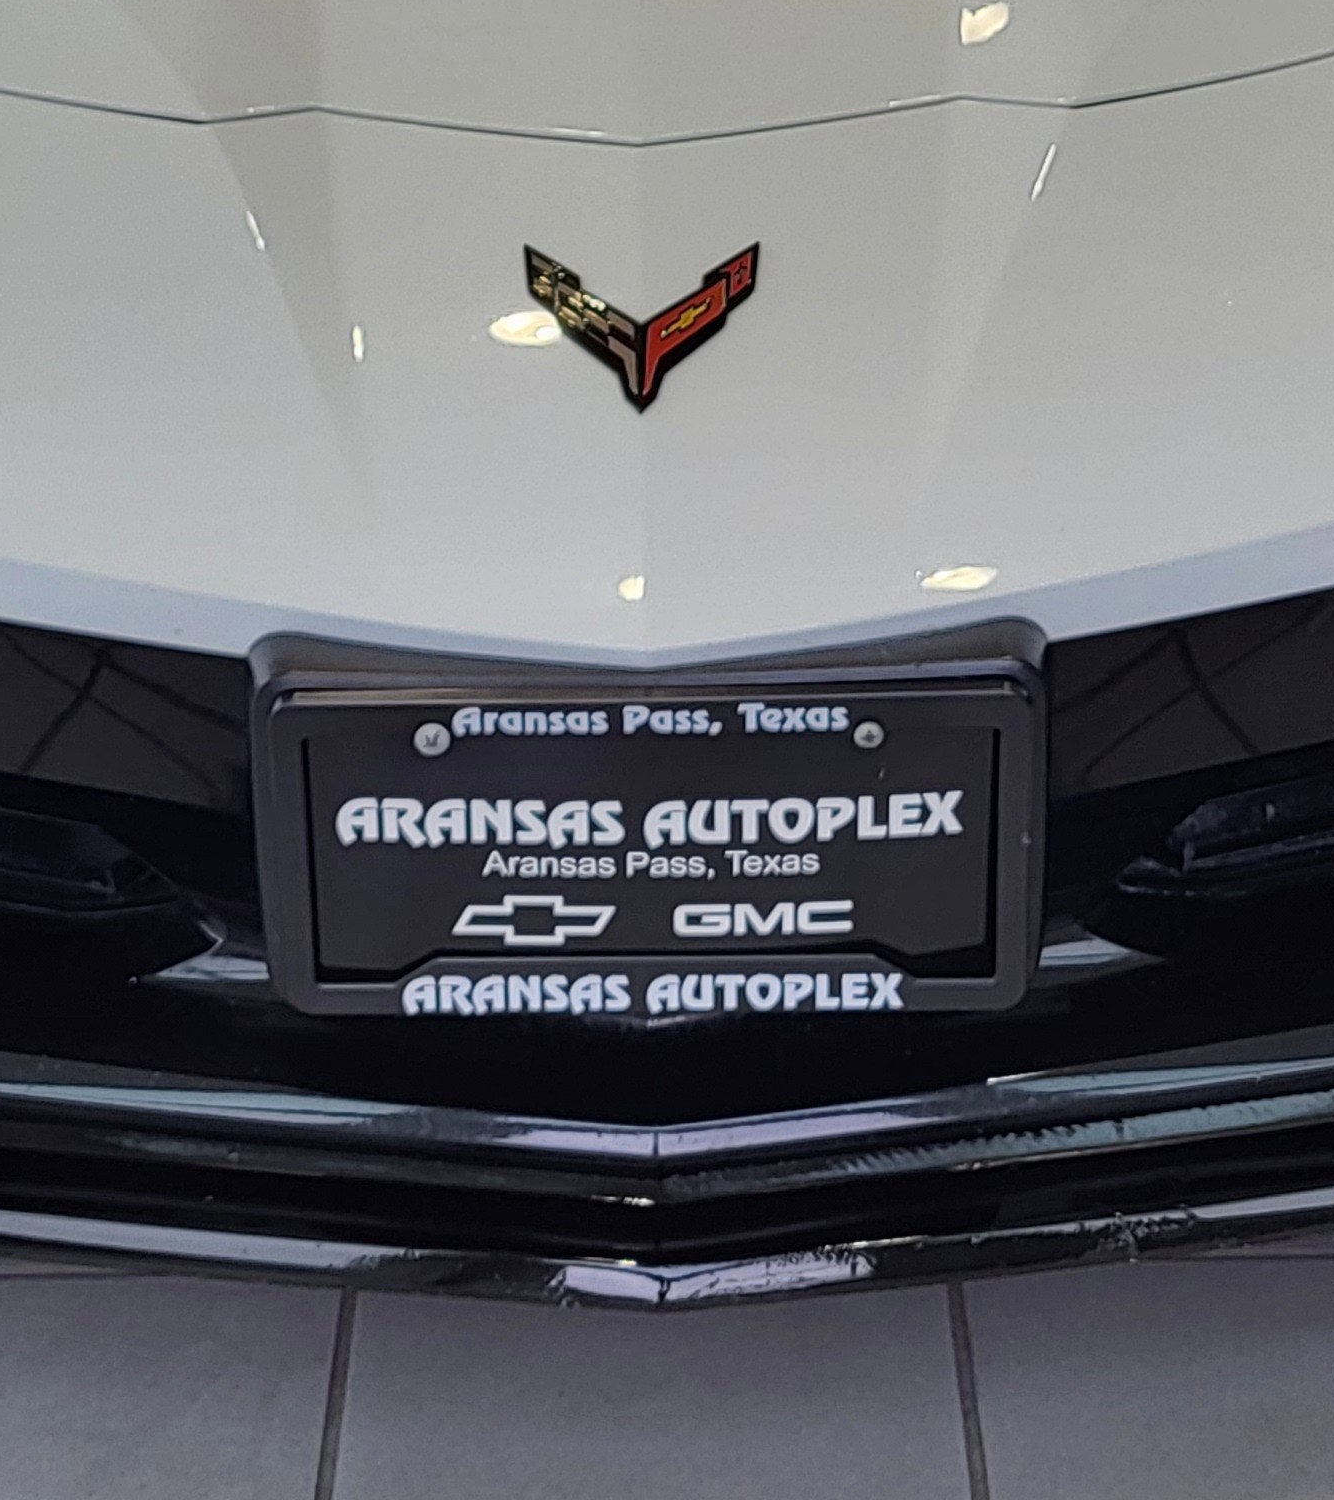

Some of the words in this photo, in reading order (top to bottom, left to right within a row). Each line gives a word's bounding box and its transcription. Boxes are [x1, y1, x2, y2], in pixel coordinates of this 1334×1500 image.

[451, 705, 610, 738] Aransas
[622, 704, 724, 737] Pass,
[736, 702, 851, 735] Texas
[335, 796, 627, 850] ARANSAS
[643, 789, 965, 850] AUTOPLEX
[481, 849, 617, 880] Aransas
[625, 851, 717, 881] Pass,
[724, 849, 822, 878] Texas
[671, 899, 856, 939] GMC
[401, 972, 632, 1017] ARANSAS
[645, 971, 906, 1017] AUTOPLEX
